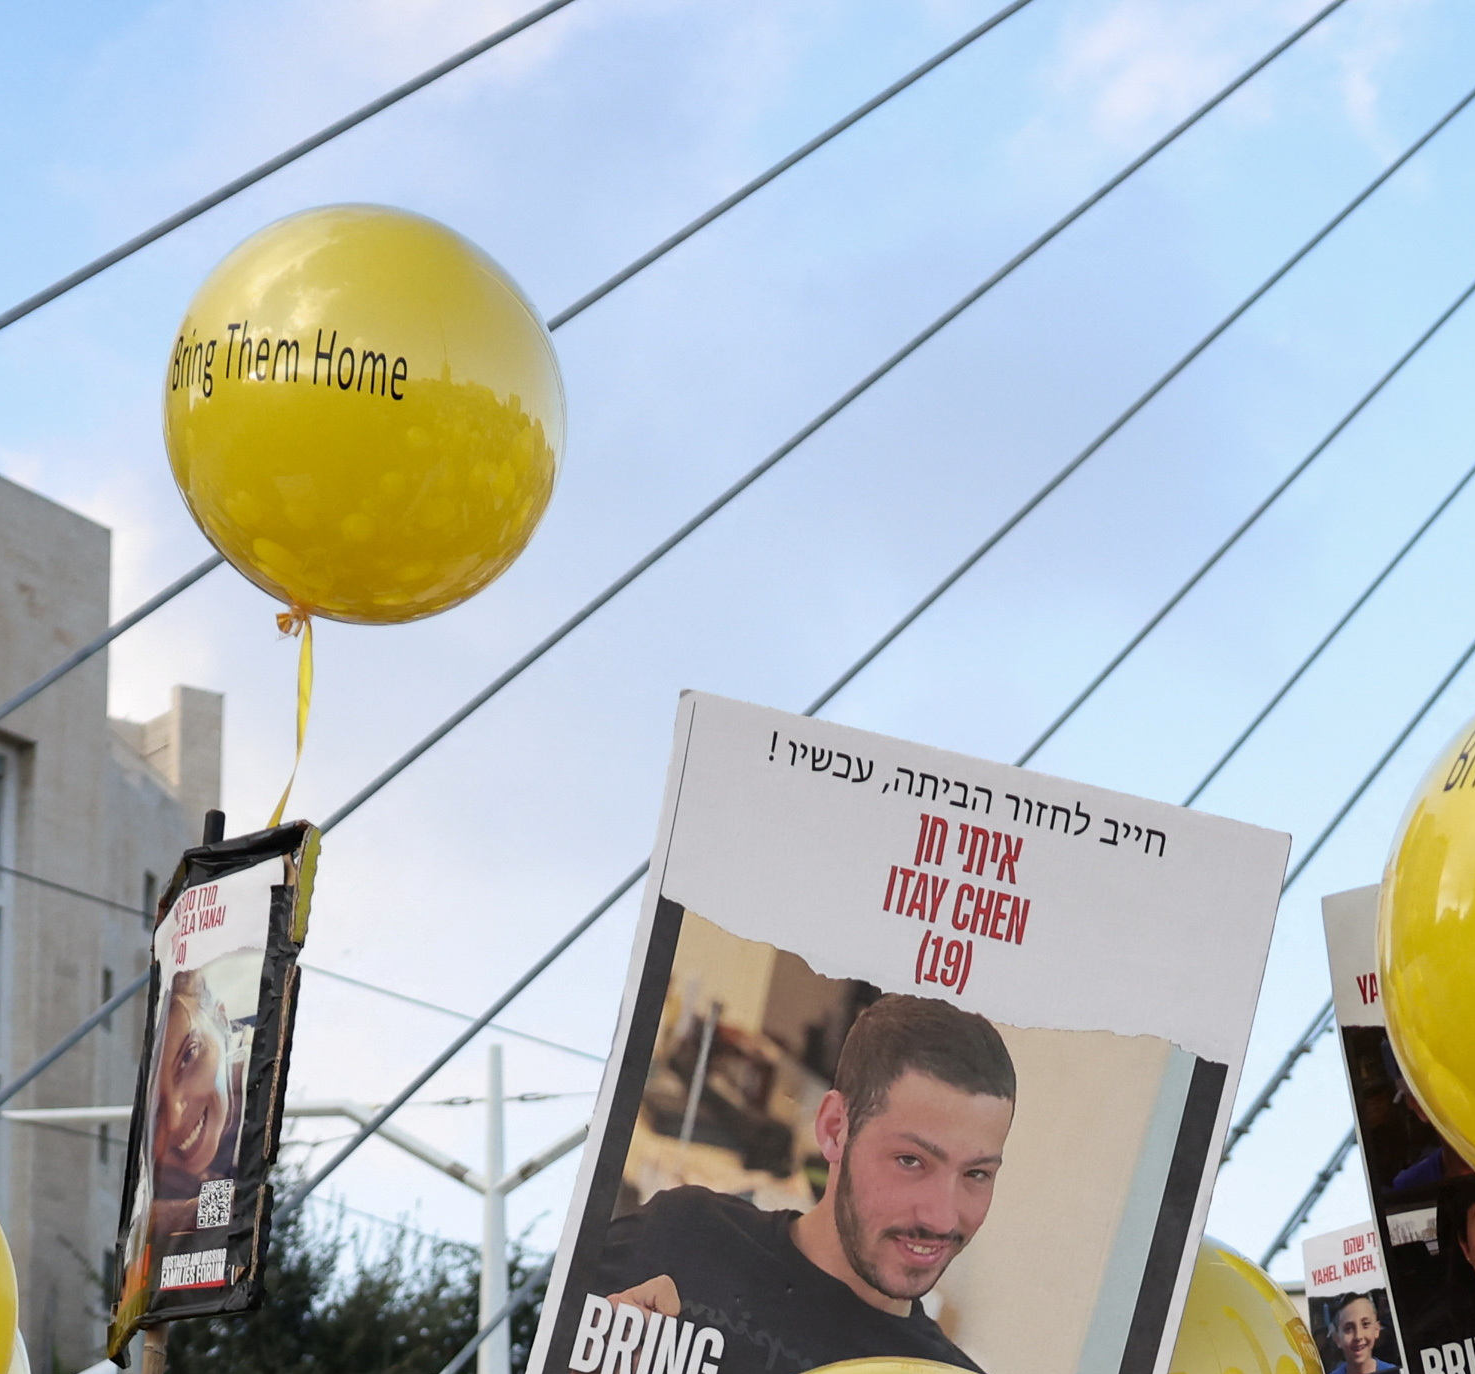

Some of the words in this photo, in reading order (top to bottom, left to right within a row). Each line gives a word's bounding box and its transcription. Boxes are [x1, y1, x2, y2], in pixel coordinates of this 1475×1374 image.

[172, 327, 215, 399] Bring
[227, 322, 303, 384] Them
[313, 328, 407, 401] Home
[769, 732, 778, 762] !
[788, 740, 875, 786] עכשיו
[882, 764, 994, 815] הביתה,
[1005, 792, 1091, 838] לחזור
[914, 813, 948, 867] חן
[957, 823, 1024, 885] איתי
[1099, 815, 1168, 858] חייב
[882, 866, 947, 921] ITAY
[952, 884, 1031, 946] CHEN
[915, 930, 974, 996] (19)
